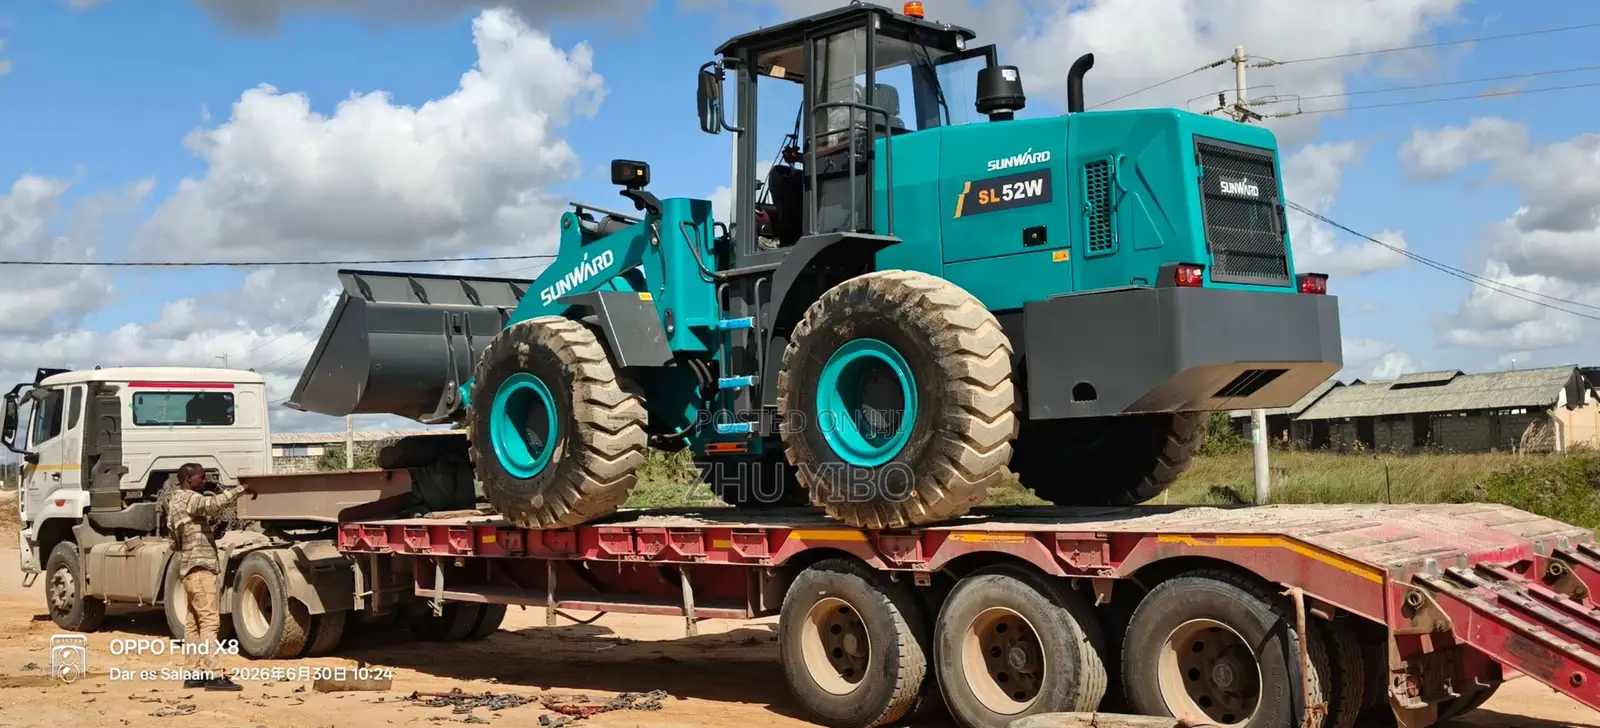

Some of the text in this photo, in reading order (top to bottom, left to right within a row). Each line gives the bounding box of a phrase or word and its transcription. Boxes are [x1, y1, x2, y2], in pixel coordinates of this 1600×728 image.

[987, 147, 1051, 172] SUNWARD
[1220, 177, 1259, 197] SUNWARD
[540, 249, 614, 307] SUNWARD
